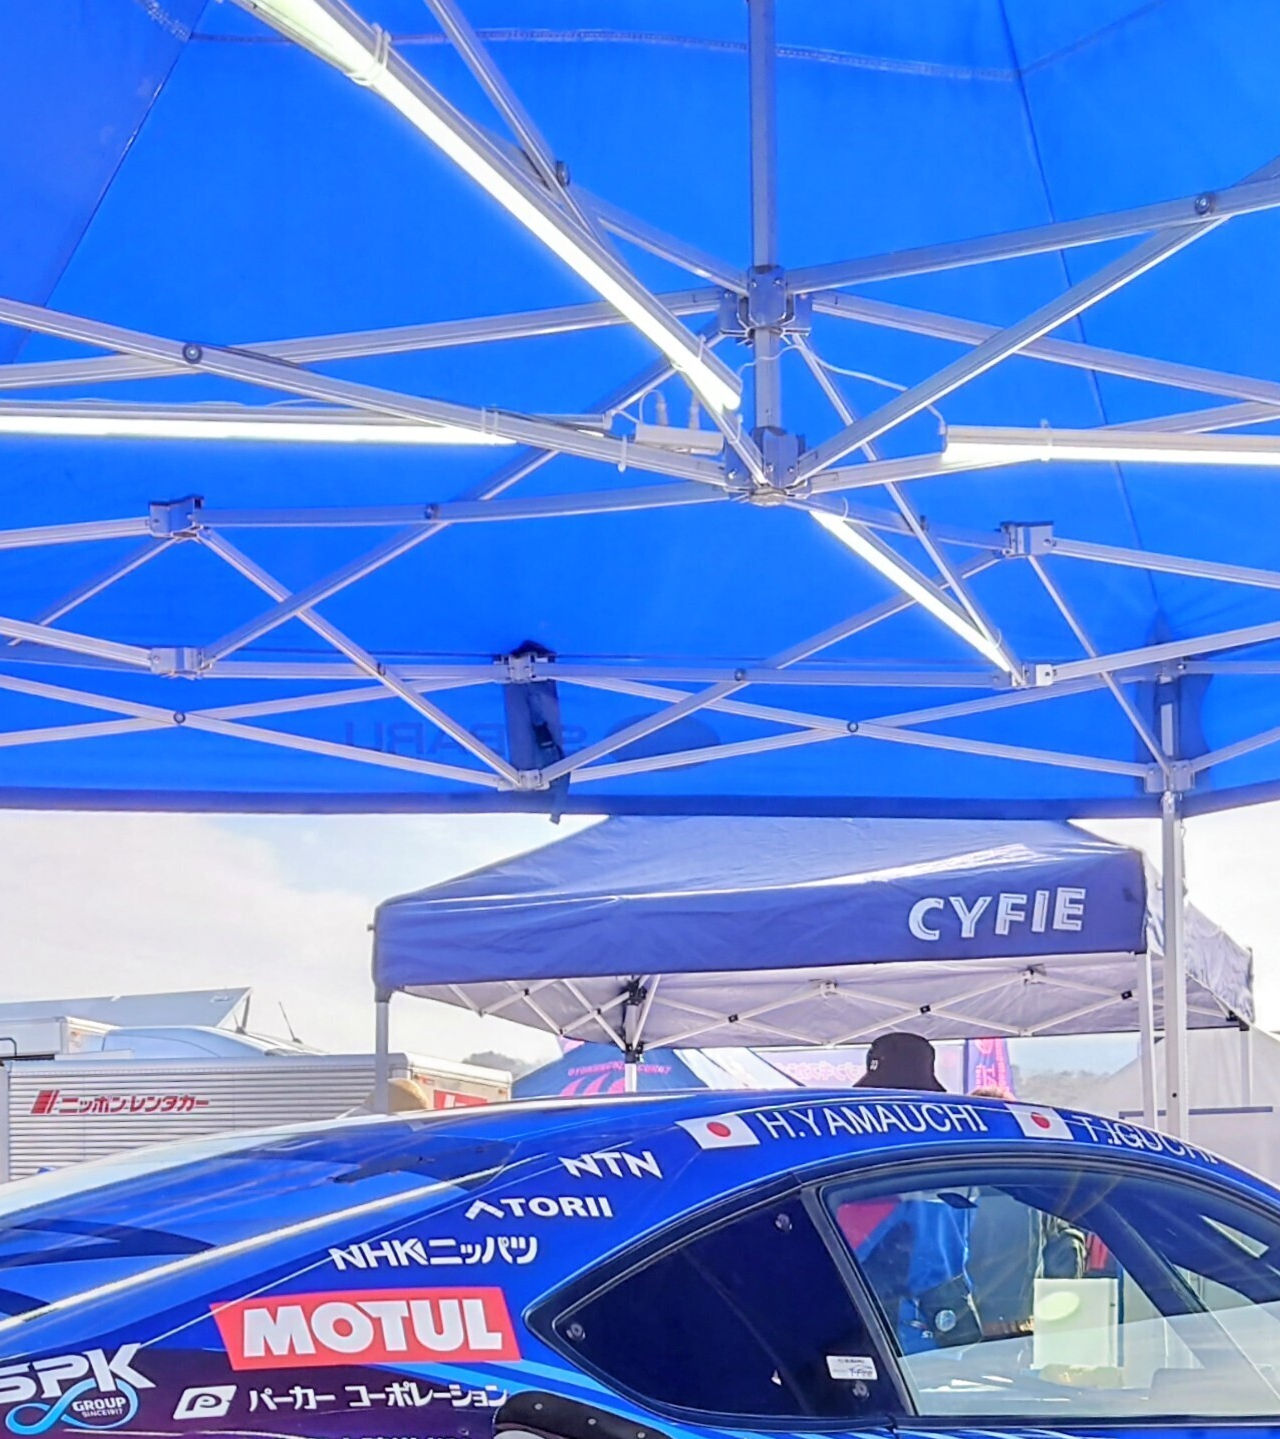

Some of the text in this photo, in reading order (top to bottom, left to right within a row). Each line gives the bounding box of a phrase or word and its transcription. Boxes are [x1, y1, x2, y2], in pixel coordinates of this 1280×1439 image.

[908, 886, 1086, 941] CYFIE
[59, 1095, 210, 1114] ニッポンレンタカー
[759, 1103, 989, 1140] H.YAMAUCHI
[559, 1151, 663, 1180] NTN
[242, 1298, 504, 1358] MOTUL
[73, 1397, 126, 1413] GROUP
[249, 1382, 508, 1411] パーカー コーポレーション
